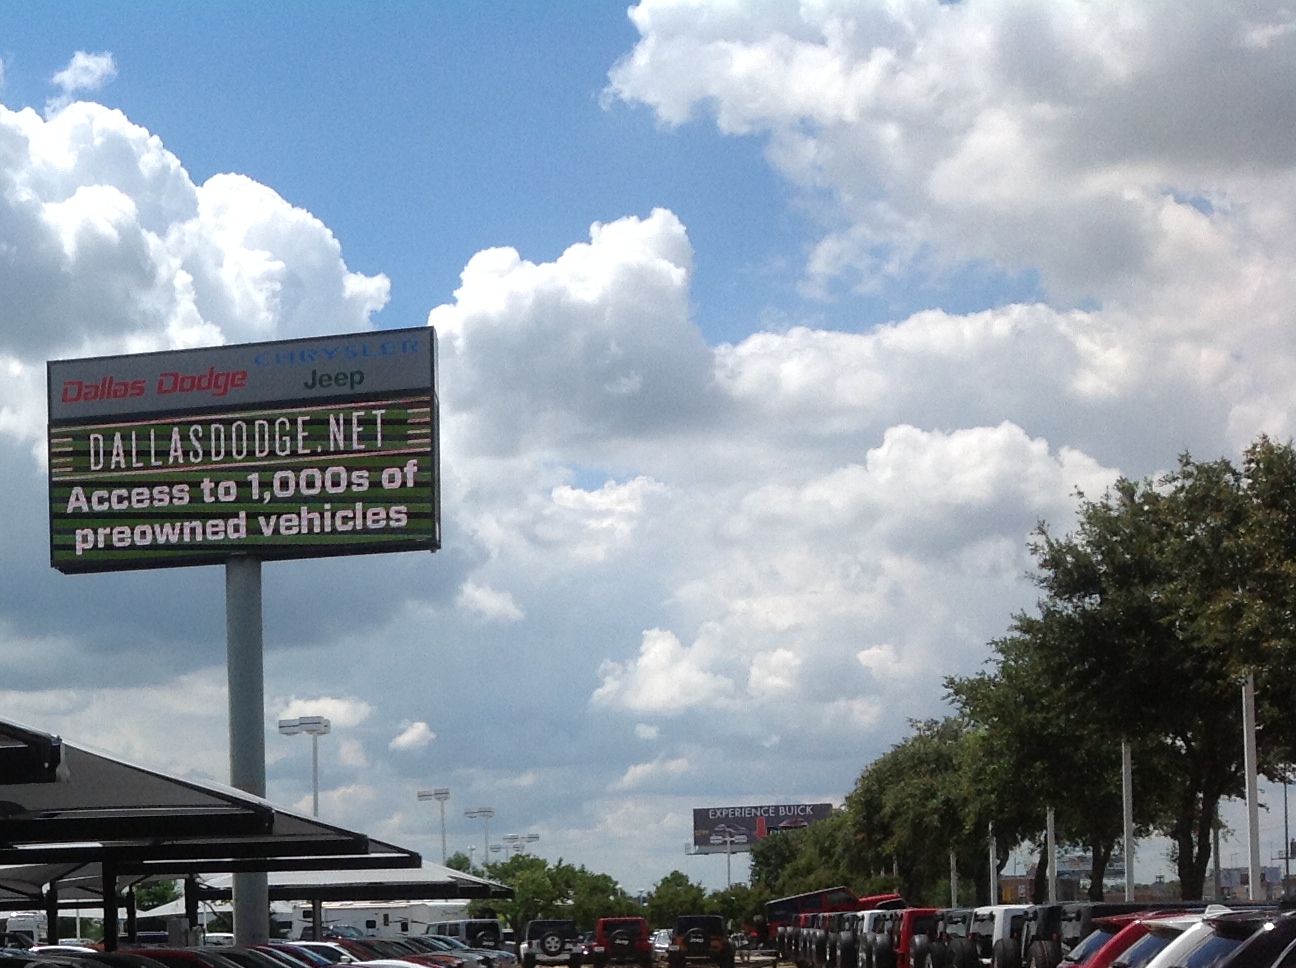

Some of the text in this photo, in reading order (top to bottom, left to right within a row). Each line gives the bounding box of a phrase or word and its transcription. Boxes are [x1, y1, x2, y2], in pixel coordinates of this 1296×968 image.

[255, 340, 419, 366] CHRYSLER
[61, 367, 247, 402] Dallas Dodge
[305, 369, 365, 390] Jeep
[89, 409, 386, 471] DALLASDODGE.NET
[66, 459, 418, 514] Access to 1,000s of
[75, 502, 408, 555] preowned vehicles
[708, 805, 814, 819] EXPERIENCE BUICK
